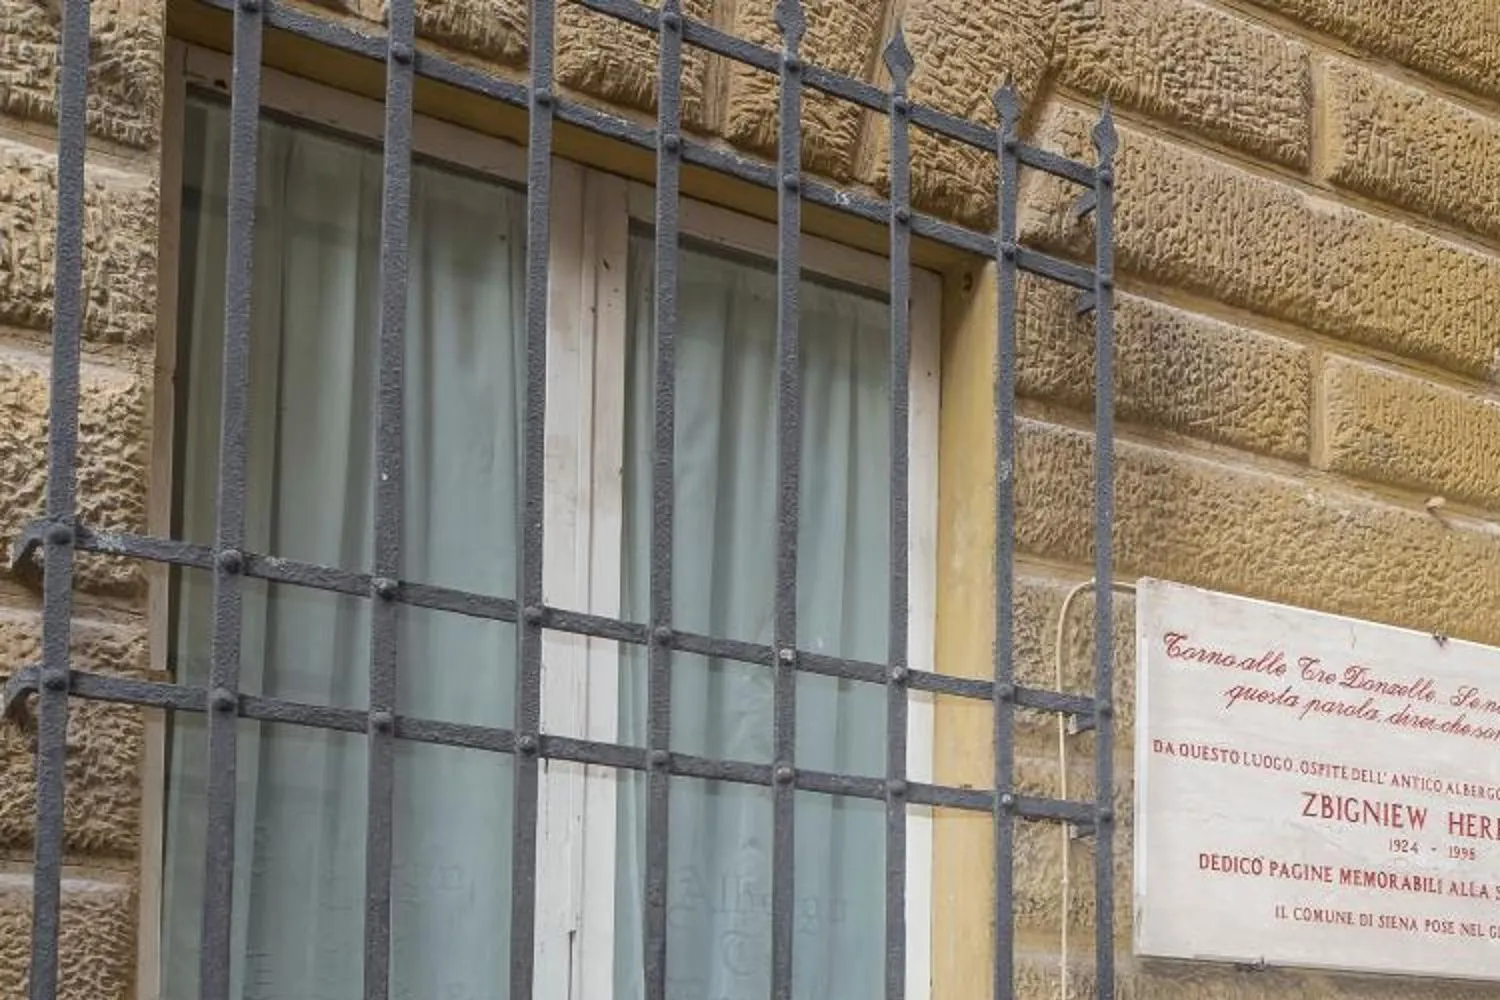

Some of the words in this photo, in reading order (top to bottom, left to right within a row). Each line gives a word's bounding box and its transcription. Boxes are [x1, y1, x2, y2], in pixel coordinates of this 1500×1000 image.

[1164, 632, 1235, 667] Torno
[1238, 651, 1287, 677] alle
[1298, 657, 1336, 684] Tre
[1450, 685, 1480, 708] Se
[1224, 684, 1299, 710] questa
[1440, 714, 1471, 735] che
[1153, 739, 1175, 755] DA
[1180, 743, 1239, 765] QUESTO
[1300, 760, 1348, 781] OSPITE
[1391, 774, 1442, 793] ANTICO
[1301, 791, 1428, 831] ZBIGNIEW
[1389, 839, 1418, 854] 1924
[1269, 860, 1332, 883] PAGINE
[1340, 868, 1443, 894] MEMORABILI
[1449, 881, 1489, 900] ALLA
[1275, 905, 1288, 920] IL
[1293, 907, 1354, 926] COMUNE
[1359, 913, 1373, 927] DI
[1378, 915, 1418, 932] SIENA
[1425, 919, 1455, 935] POSE
[1461, 923, 1484, 938] NEL
